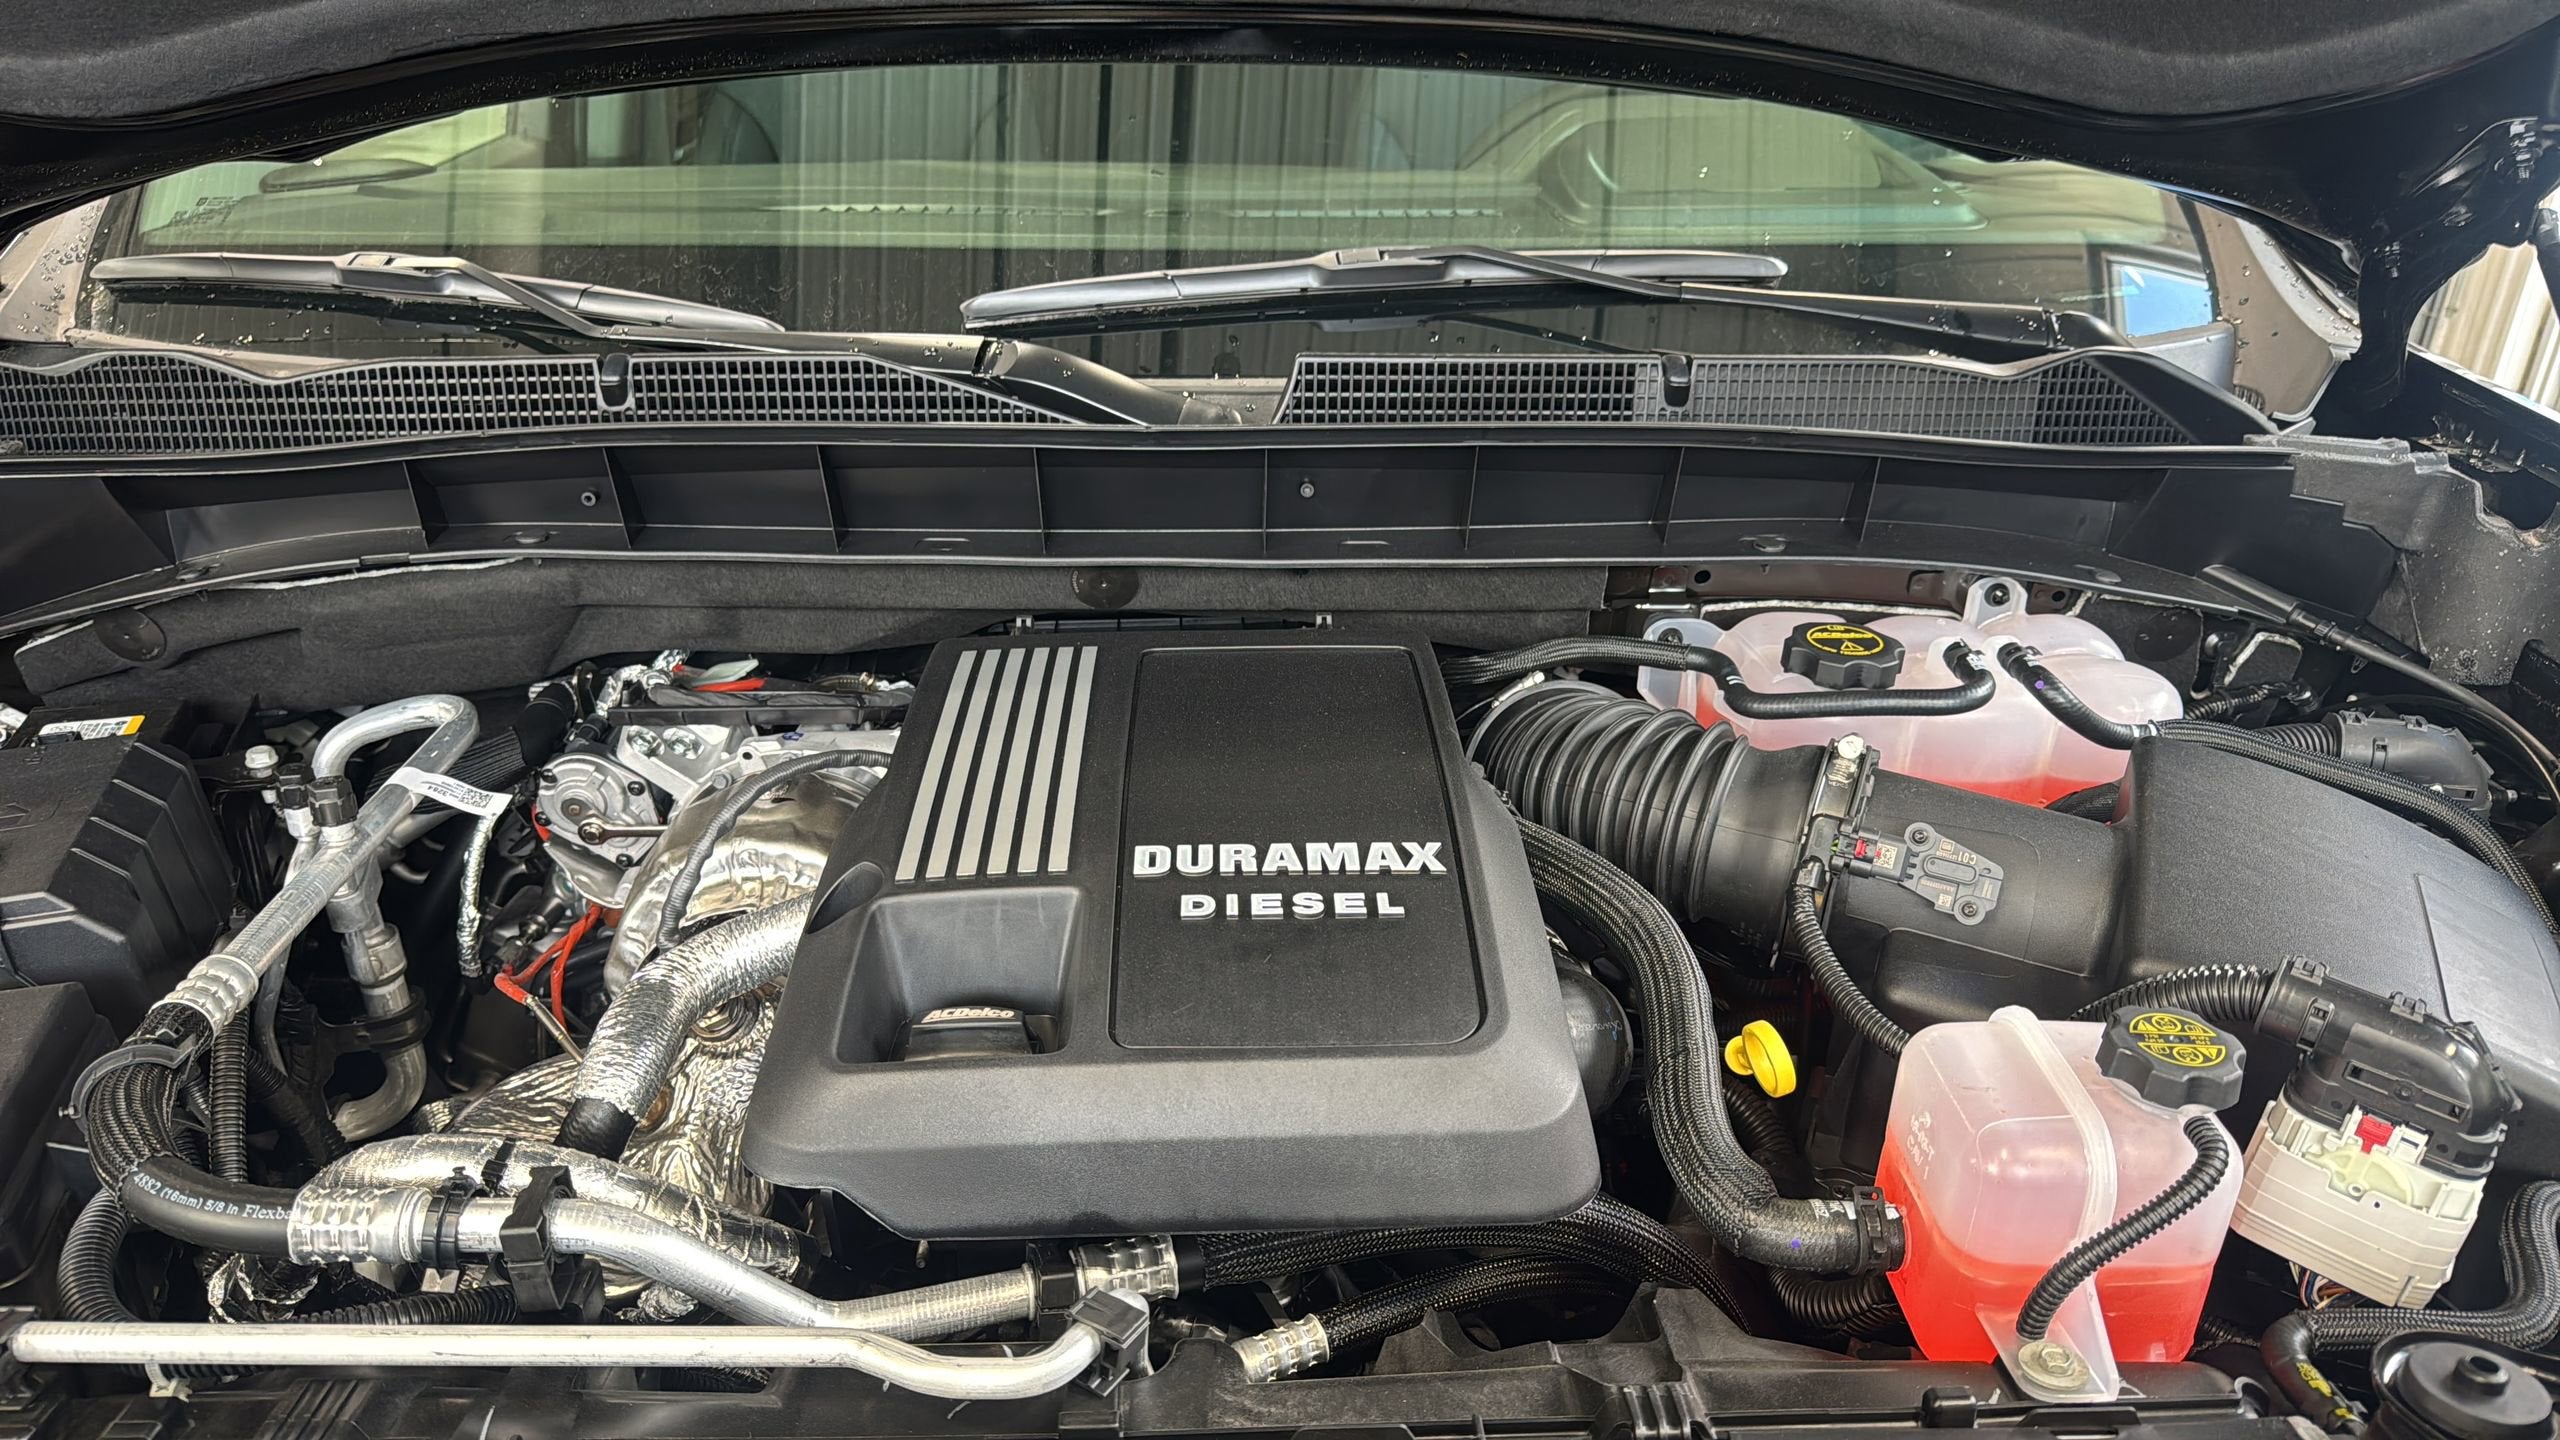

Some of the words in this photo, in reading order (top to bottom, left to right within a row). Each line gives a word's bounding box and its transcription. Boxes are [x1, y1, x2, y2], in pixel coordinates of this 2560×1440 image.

[1133, 842, 1447, 877] DURAMAX
[1180, 892, 1405, 919] DIESEL
[921, 1007, 1015, 1023] ACDelco
[160, 1187, 203, 1210] (16mm)
[205, 1200, 224, 1213] 5/8
